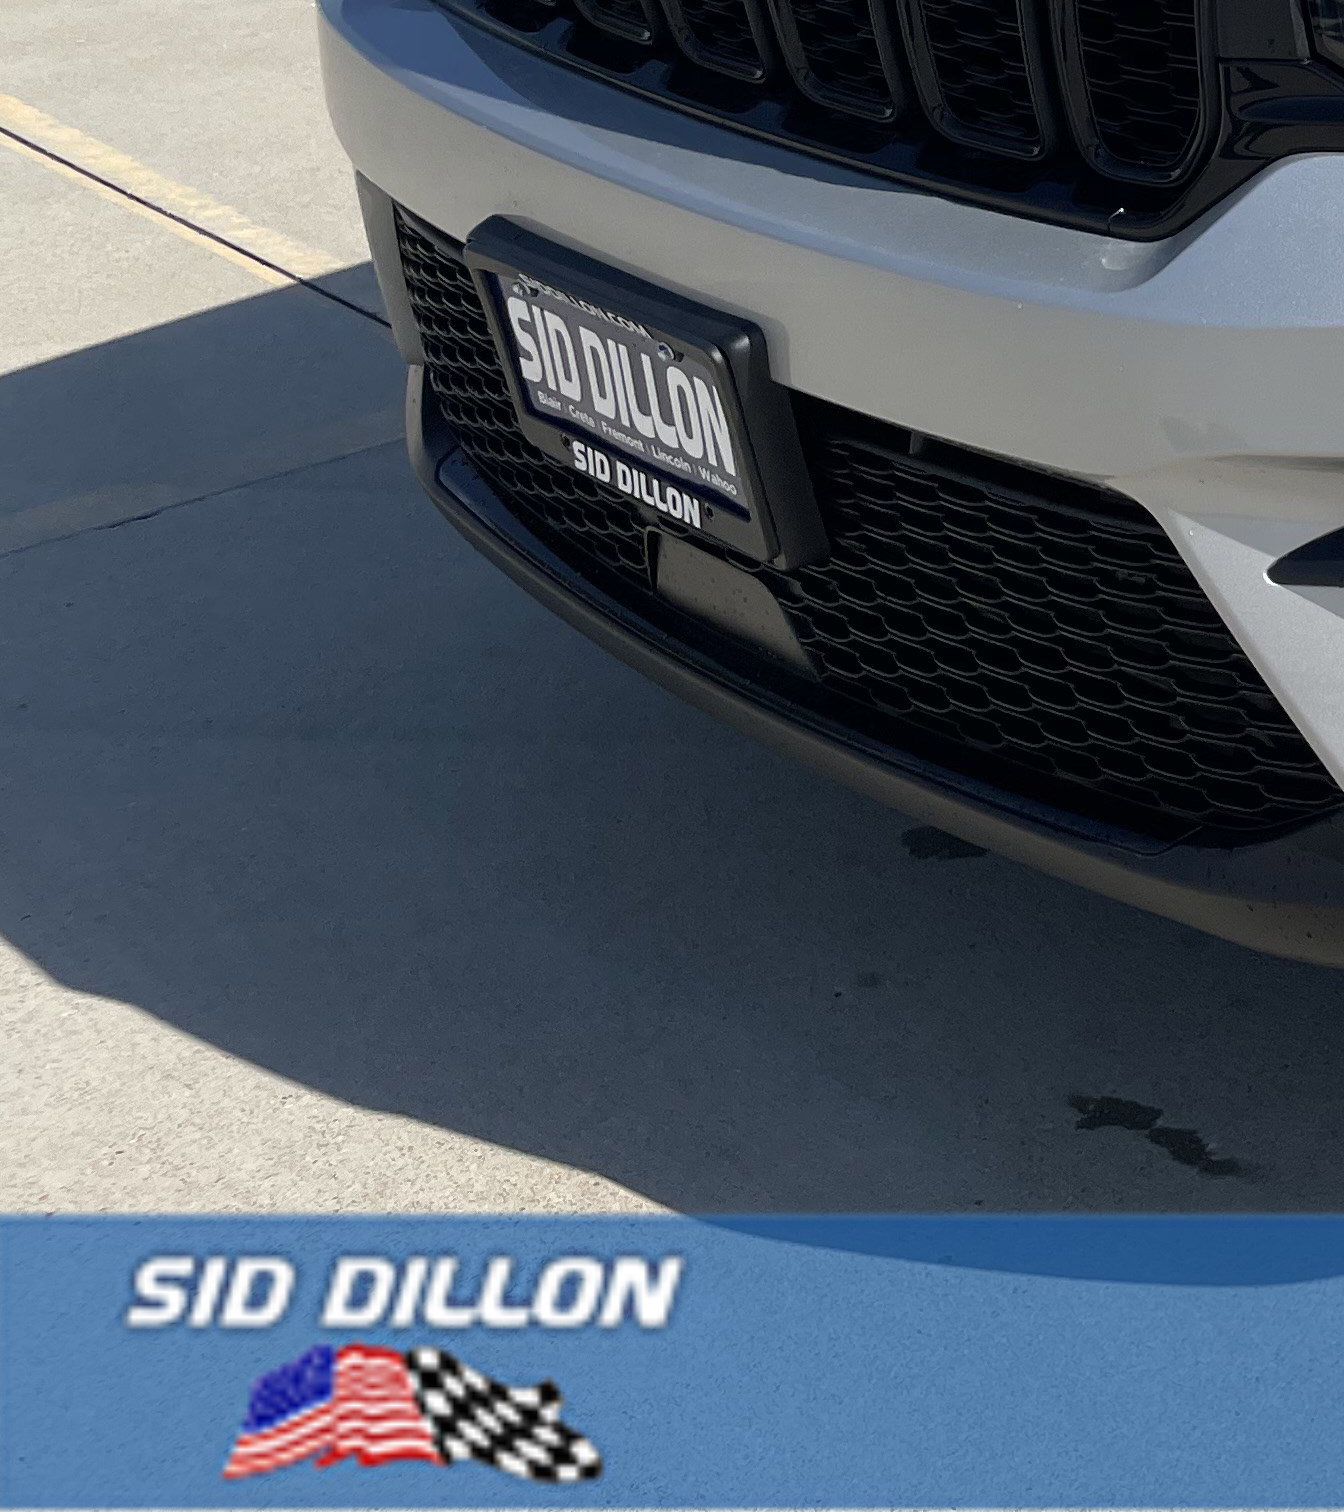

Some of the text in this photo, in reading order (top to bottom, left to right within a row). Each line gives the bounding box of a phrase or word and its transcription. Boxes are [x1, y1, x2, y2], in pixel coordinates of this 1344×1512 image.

[507, 296, 736, 478] SID DILLON
[537, 390, 738, 497] Blair Crete Fremont Lincoln Wahoo
[572, 439, 702, 530] SID DILLON
